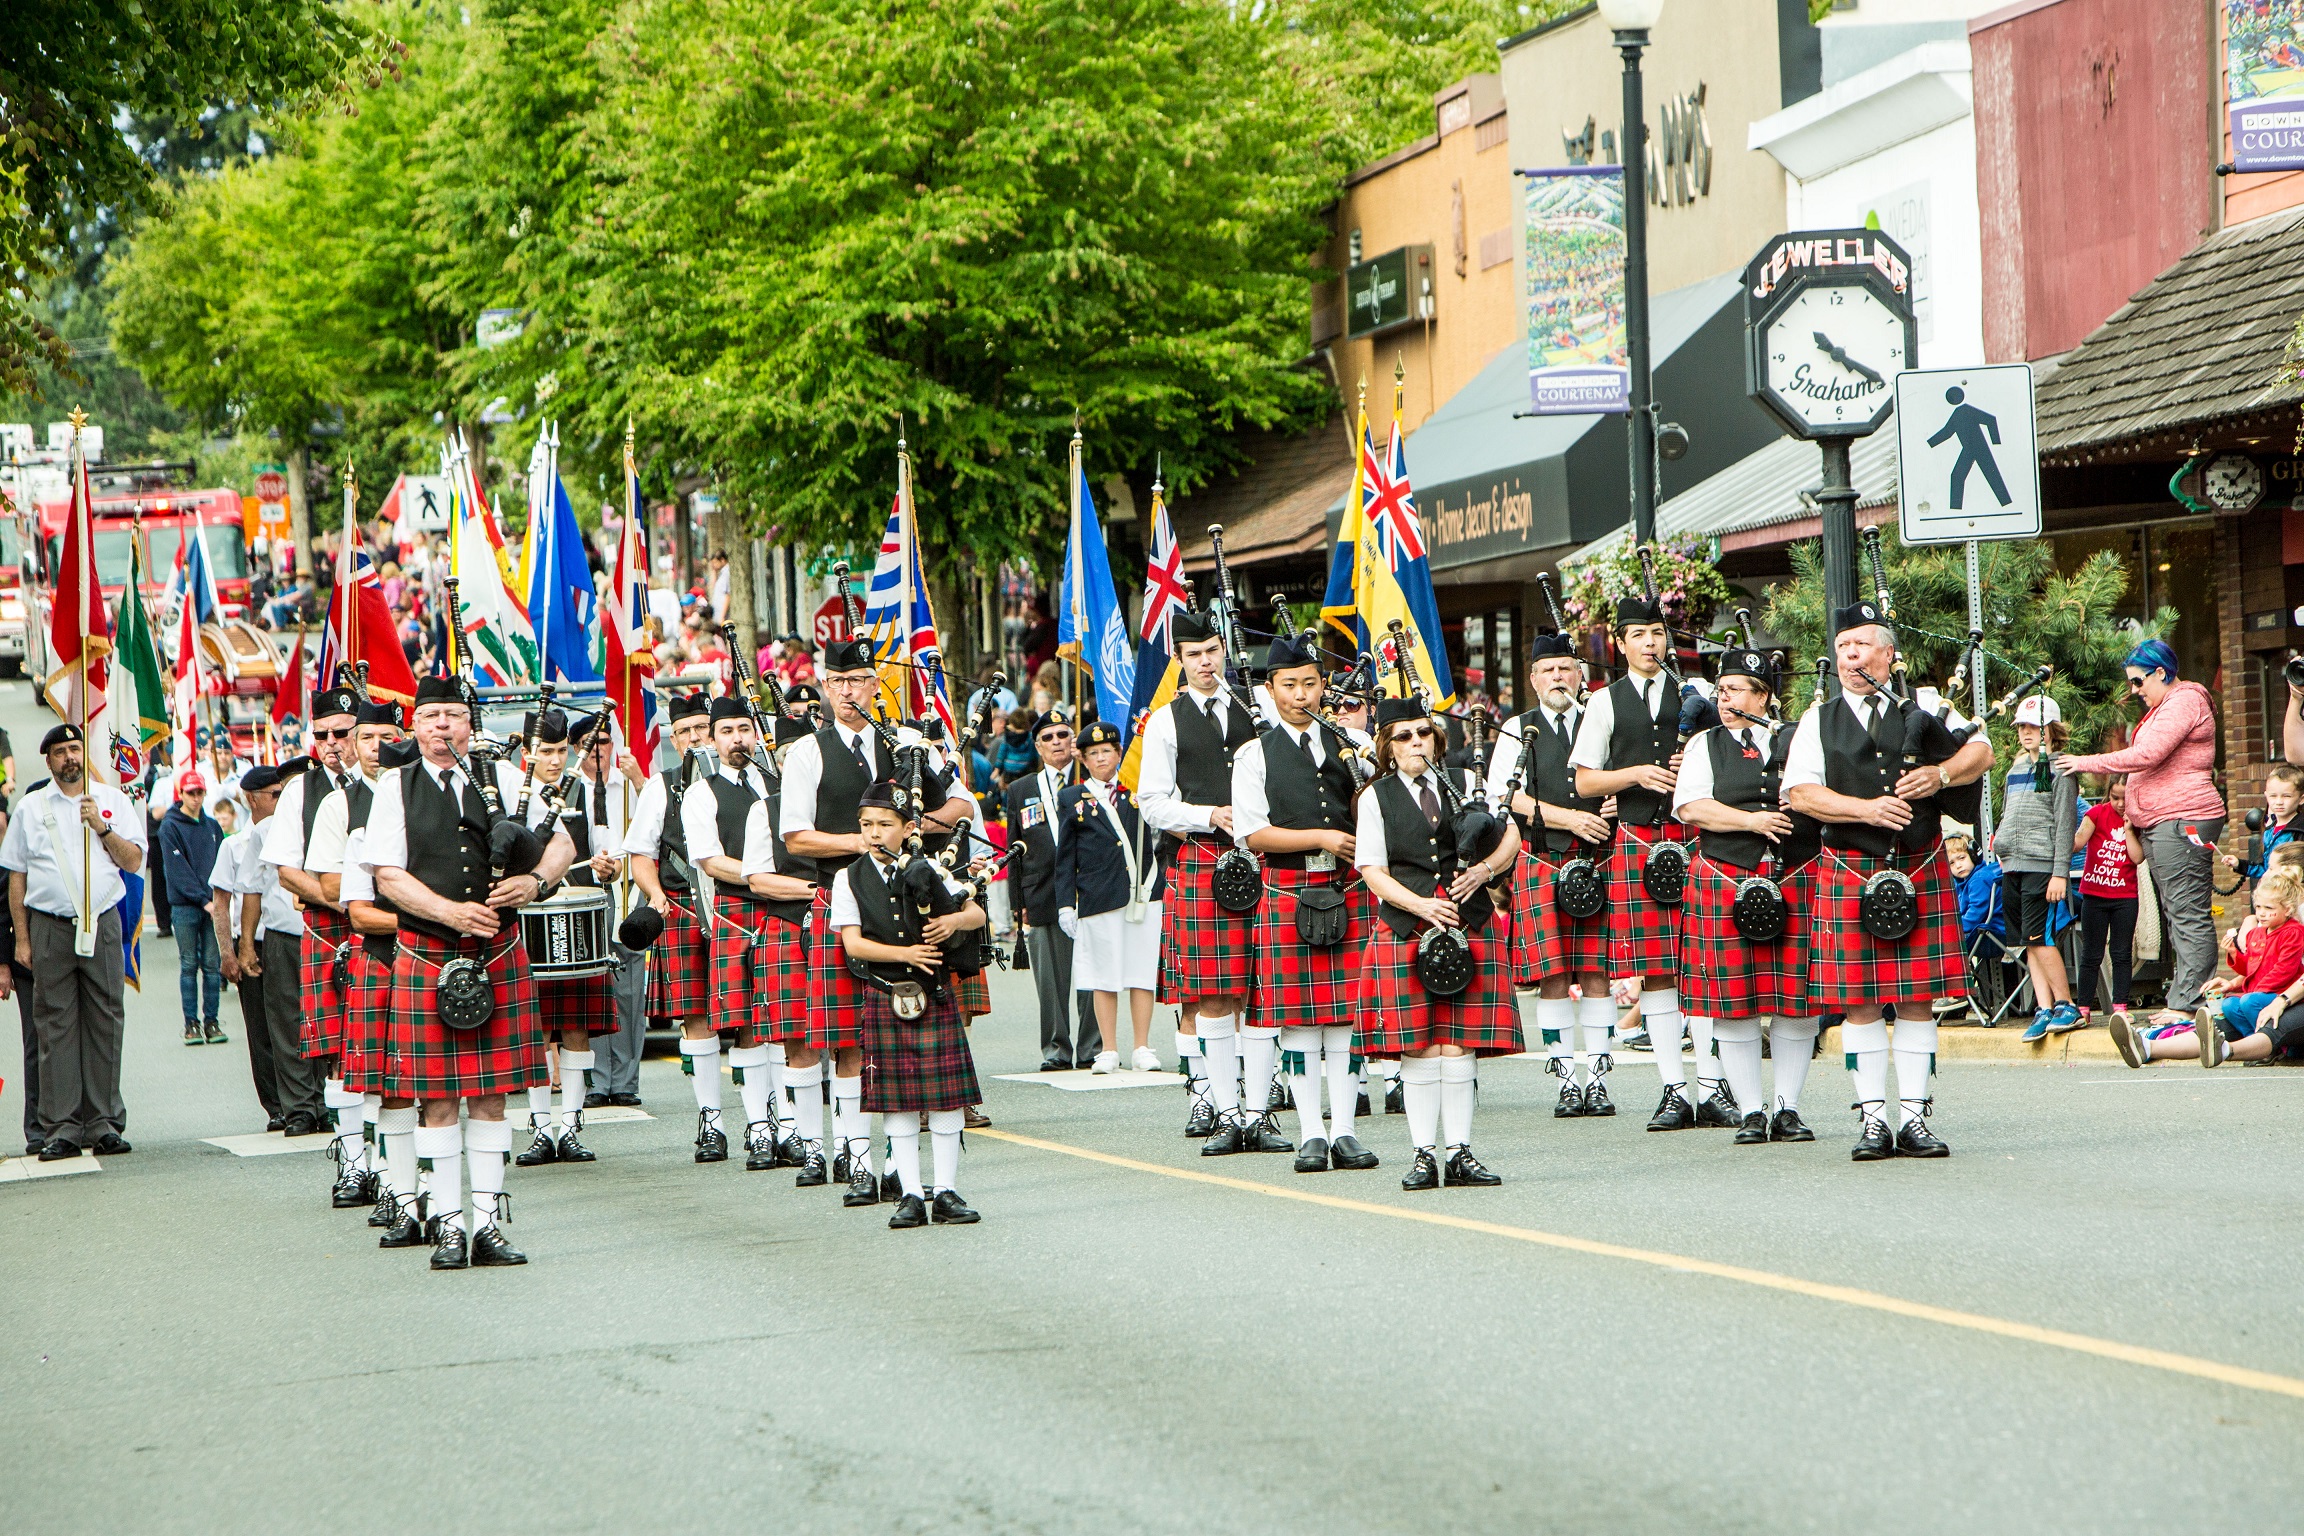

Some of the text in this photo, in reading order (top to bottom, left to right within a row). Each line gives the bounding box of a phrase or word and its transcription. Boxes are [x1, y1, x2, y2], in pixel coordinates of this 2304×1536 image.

[1830, 296, 1844, 305] 12
[1778, 353, 1785, 362] 9
[1890, 349, 1897, 357] 3
[1537, 387, 1621, 402] COURTENAY
[1836, 406, 1843, 415] 6
[1436, 499, 1464, 546] Home
[1465, 490, 1492, 541] decor
[1491, 485, 1500, 534] &
[1501, 477, 1533, 542] design
[2102, 839, 2126, 852] KEEP
[2096, 849, 2127, 862] CALM
[2102, 859, 2115, 867] AND
[2093, 864, 2120, 877] LOVE
[2083, 873, 2126, 887] CANADA
[559, 914, 568, 938] COMOX
[551, 915, 560, 957] PIPE BAND
[575, 913, 583, 960] Premier
